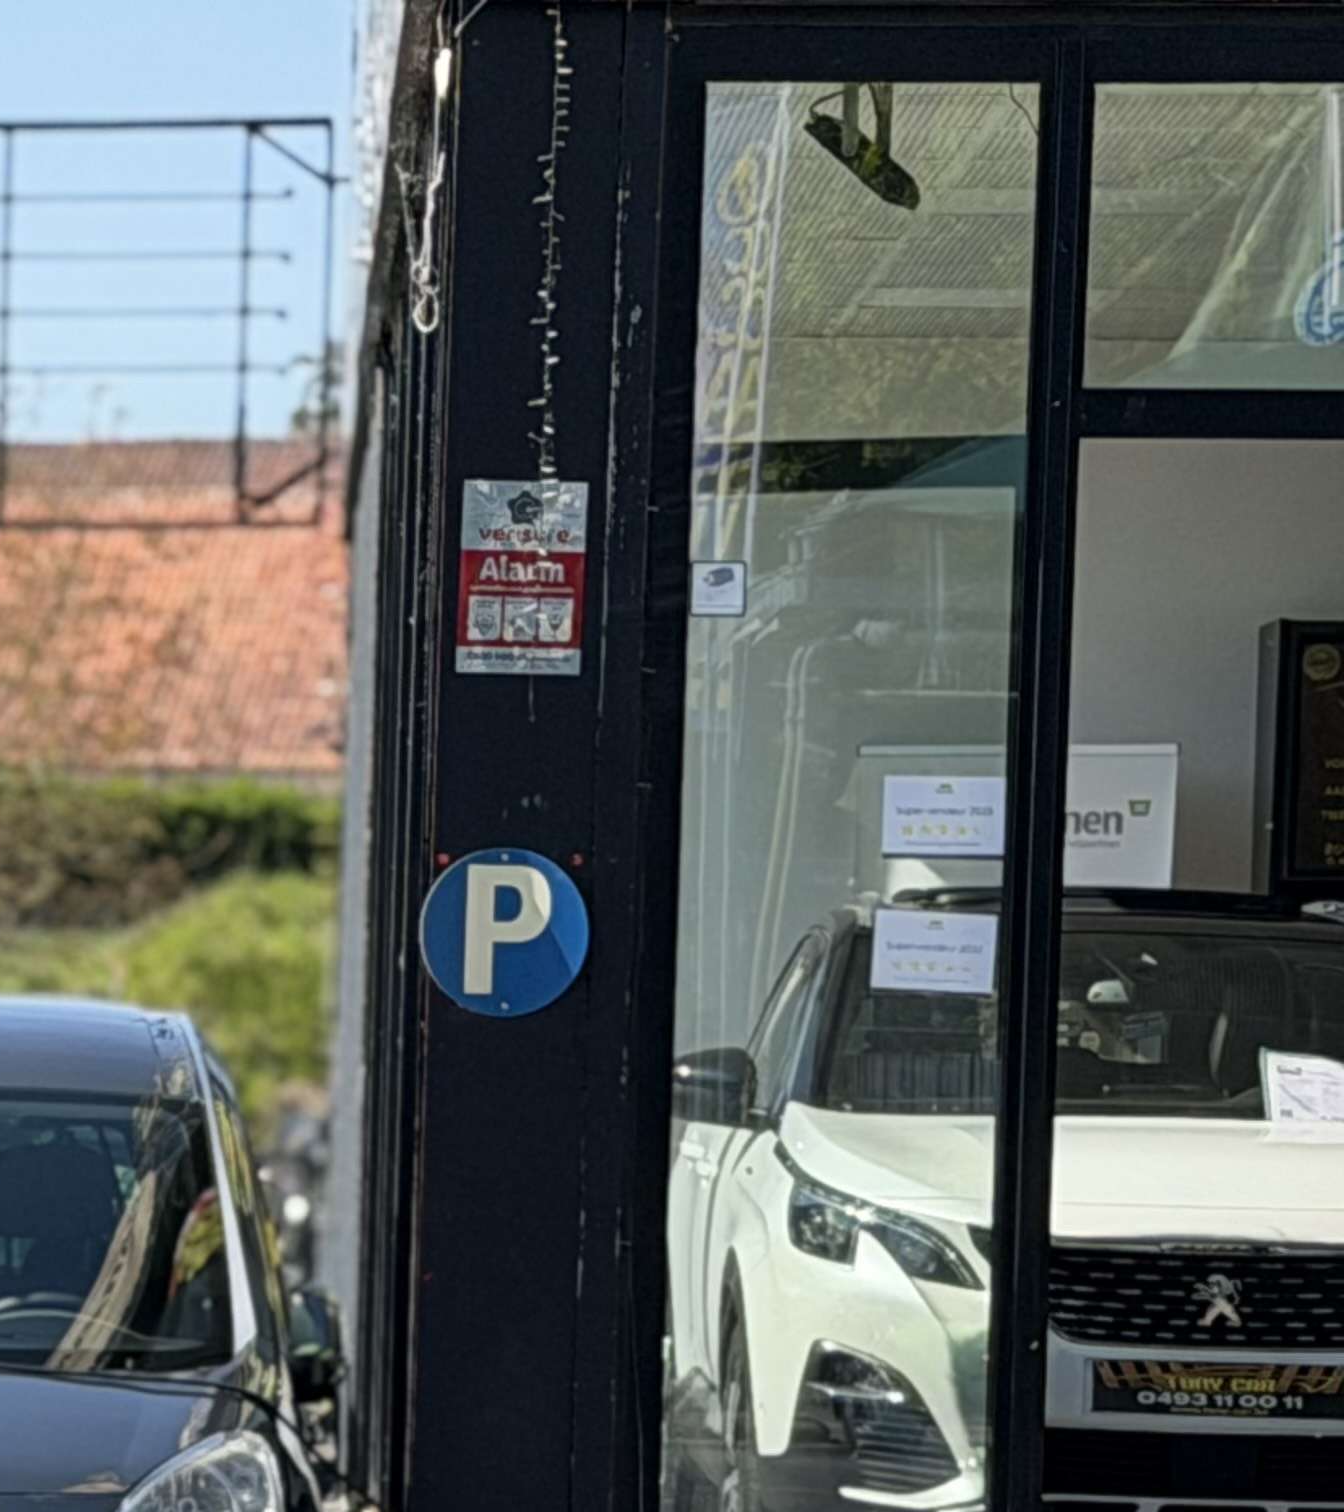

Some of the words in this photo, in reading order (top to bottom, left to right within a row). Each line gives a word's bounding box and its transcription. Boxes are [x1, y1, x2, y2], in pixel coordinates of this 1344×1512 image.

[479, 555, 566, 583] Alarm
[463, 864, 551, 994] P
[1136, 1390, 1208, 1407] 0493
[1213, 1393, 1233, 1408] 11
[1238, 1394, 1277, 1409] 00
[1282, 1395, 1304, 1411] 11
